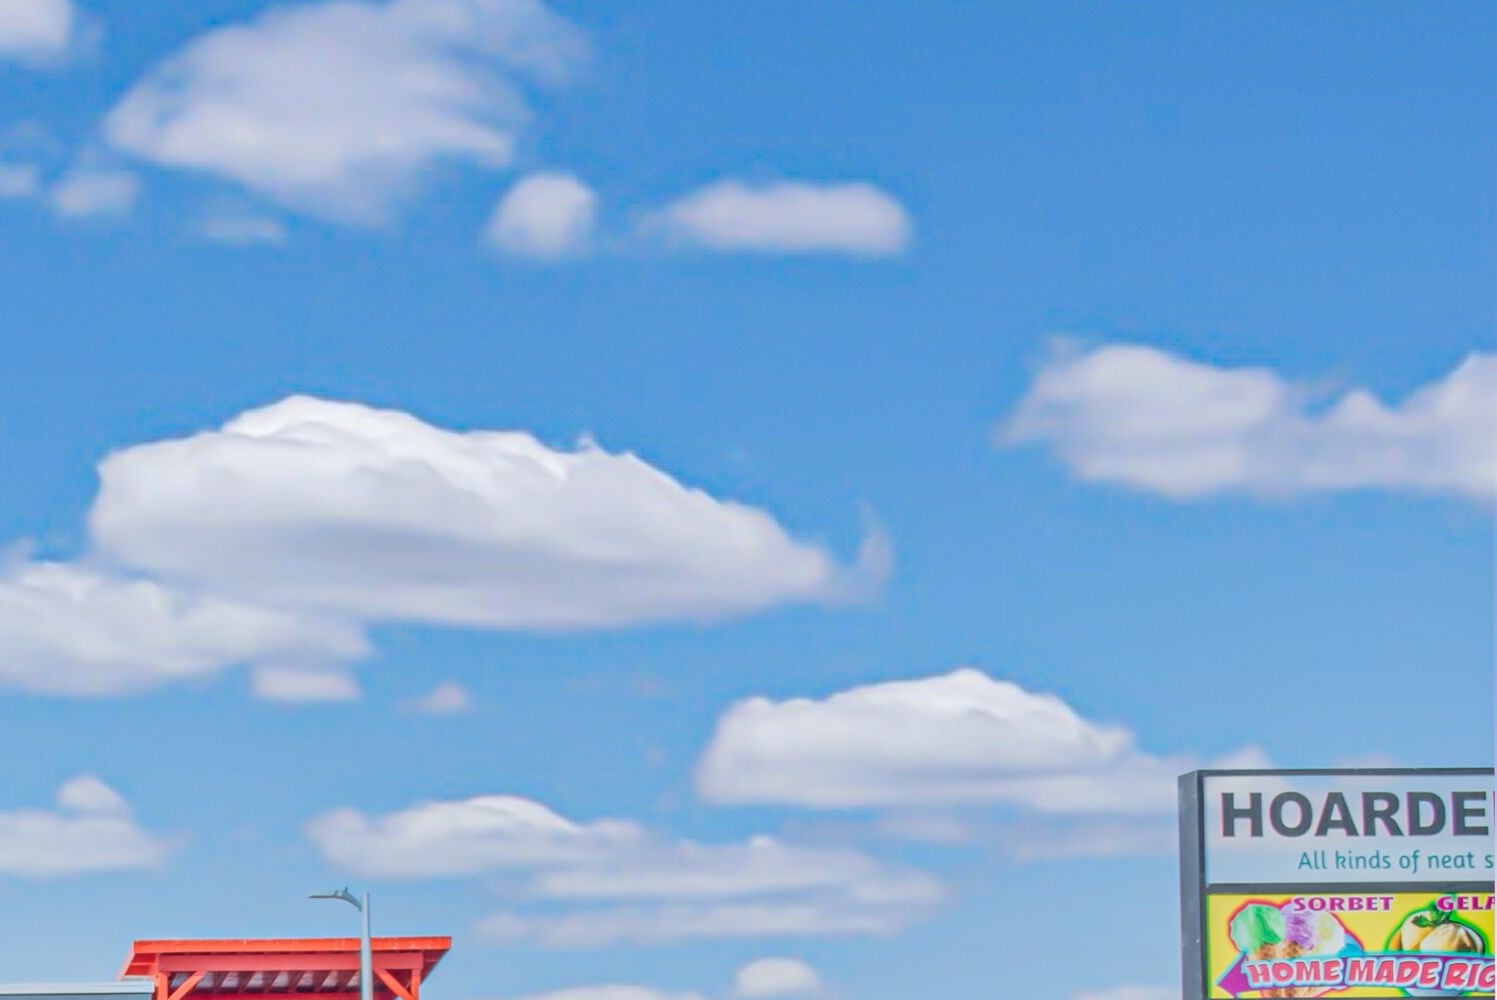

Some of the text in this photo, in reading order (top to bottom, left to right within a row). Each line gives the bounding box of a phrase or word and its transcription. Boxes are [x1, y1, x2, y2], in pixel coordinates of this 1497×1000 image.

[1221, 790, 1495, 838] HOARDE
[1298, 850, 1328, 870] All
[1335, 849, 1391, 870] kinds
[1399, 849, 1420, 874] of
[1427, 851, 1475, 870] neat
[1293, 896, 1394, 912] SORBET
[1246, 960, 1343, 985] HOME
[1348, 959, 1438, 985] MADE
